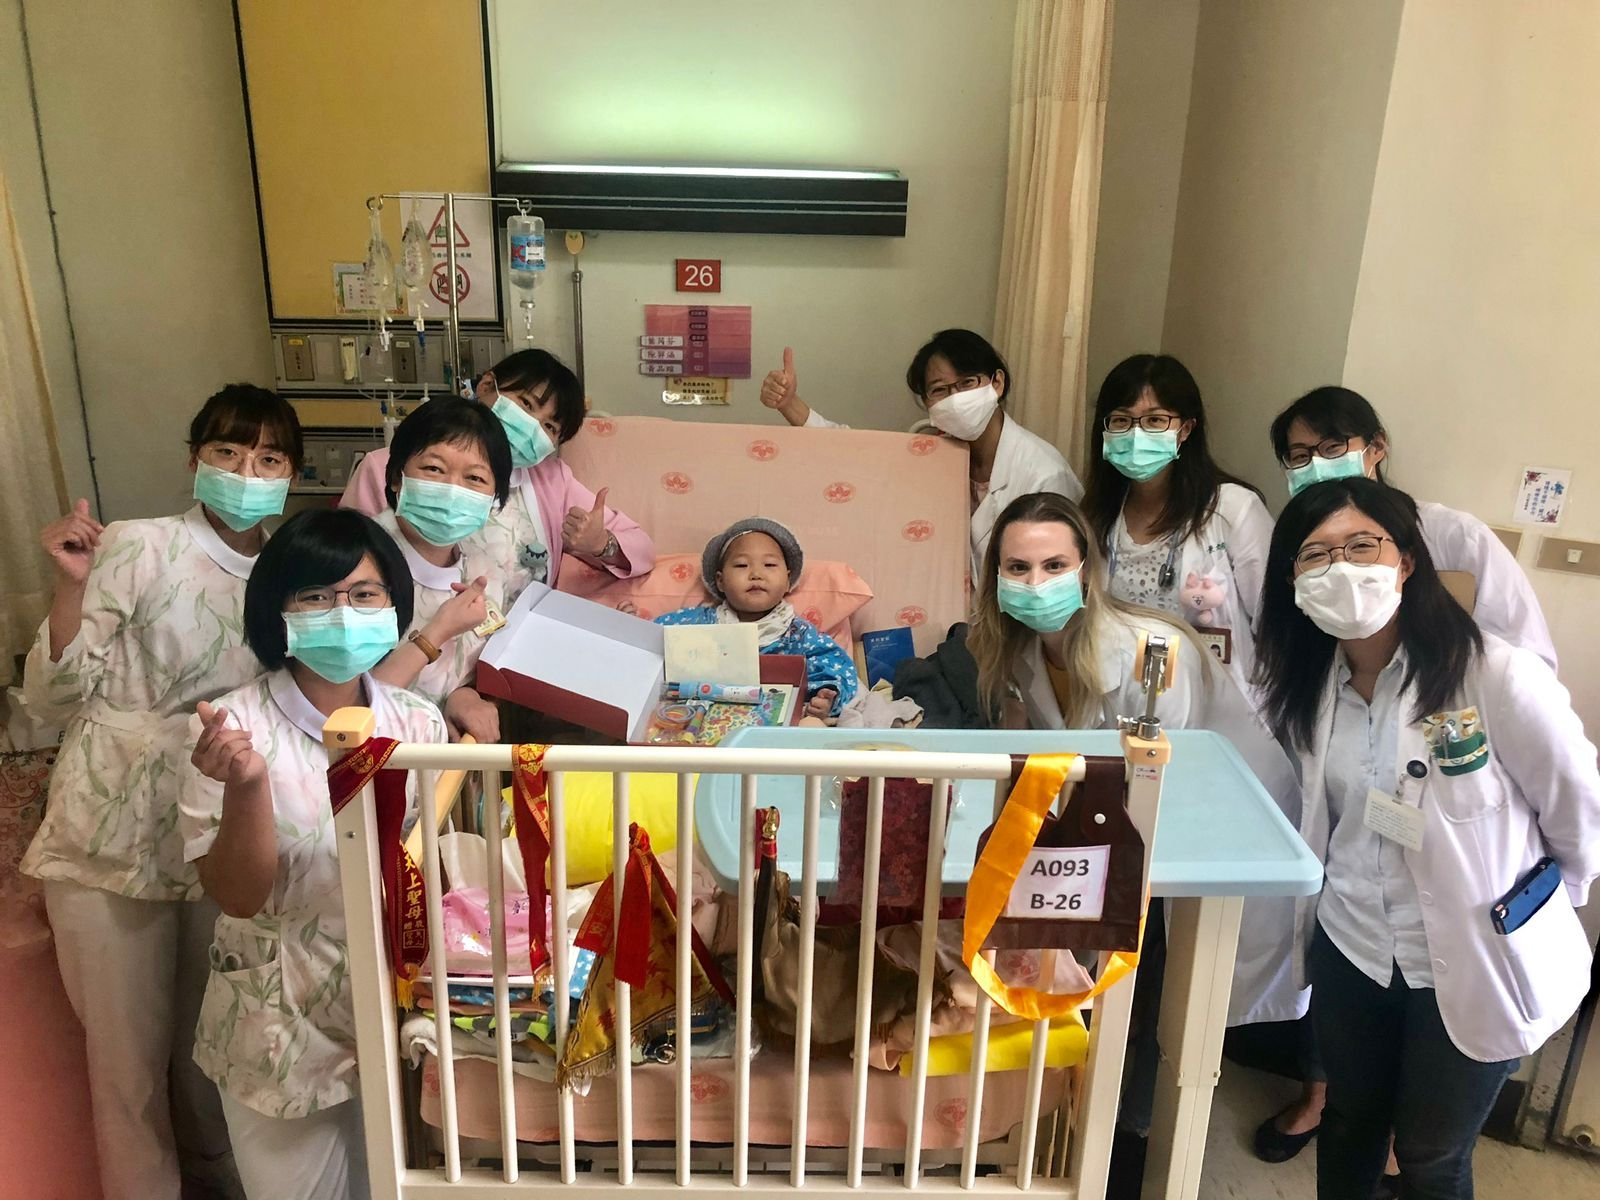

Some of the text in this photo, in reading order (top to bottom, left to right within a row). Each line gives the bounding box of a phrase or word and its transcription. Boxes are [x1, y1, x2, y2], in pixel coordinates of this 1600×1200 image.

[684, 265, 713, 287] 26
[1030, 859, 1090, 877] A093
[1030, 893, 1082, 911] B-26
